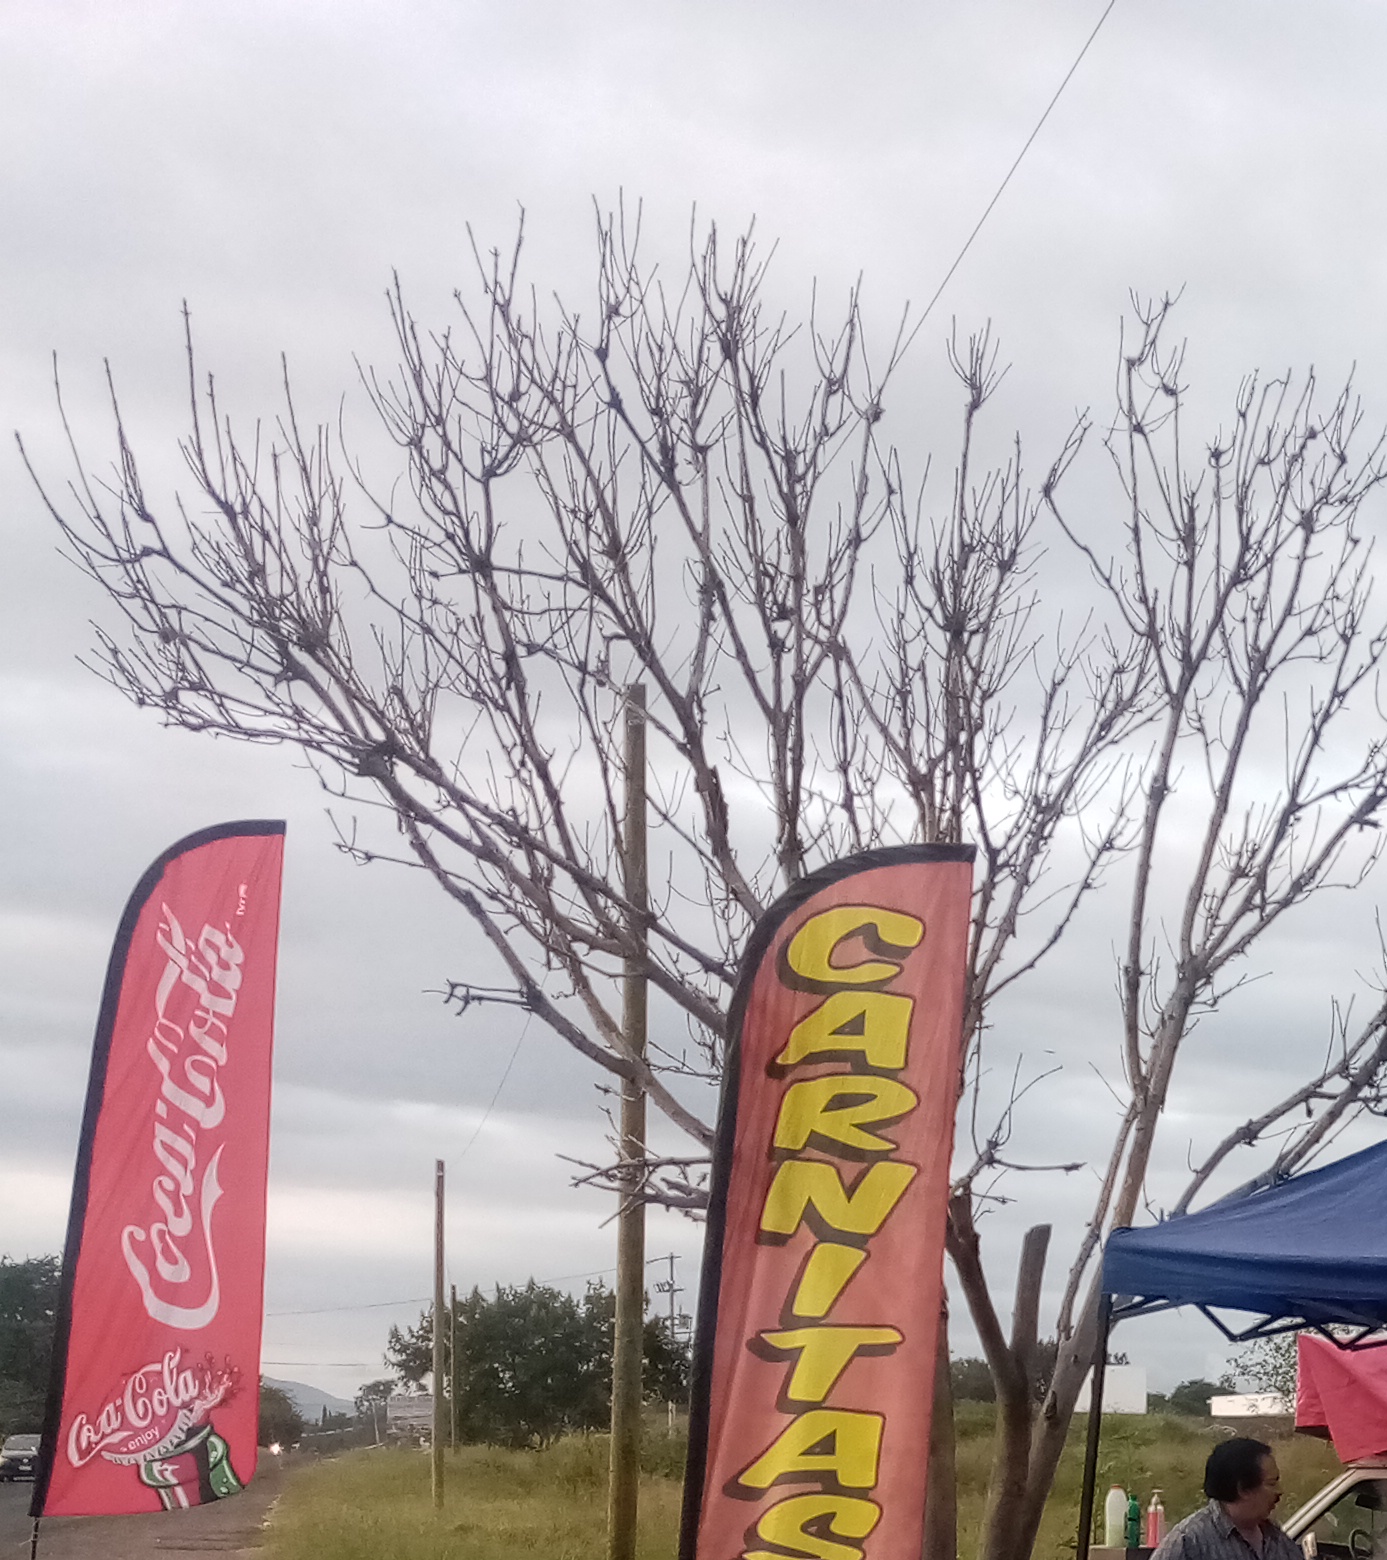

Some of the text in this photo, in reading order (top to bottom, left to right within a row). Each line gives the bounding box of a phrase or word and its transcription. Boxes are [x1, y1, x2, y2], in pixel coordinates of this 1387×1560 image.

[121, 901, 245, 1330] Coca-Cola
[67, 1347, 199, 1467] Coca-Cola
[128, 1425, 160, 1451] enjoy
